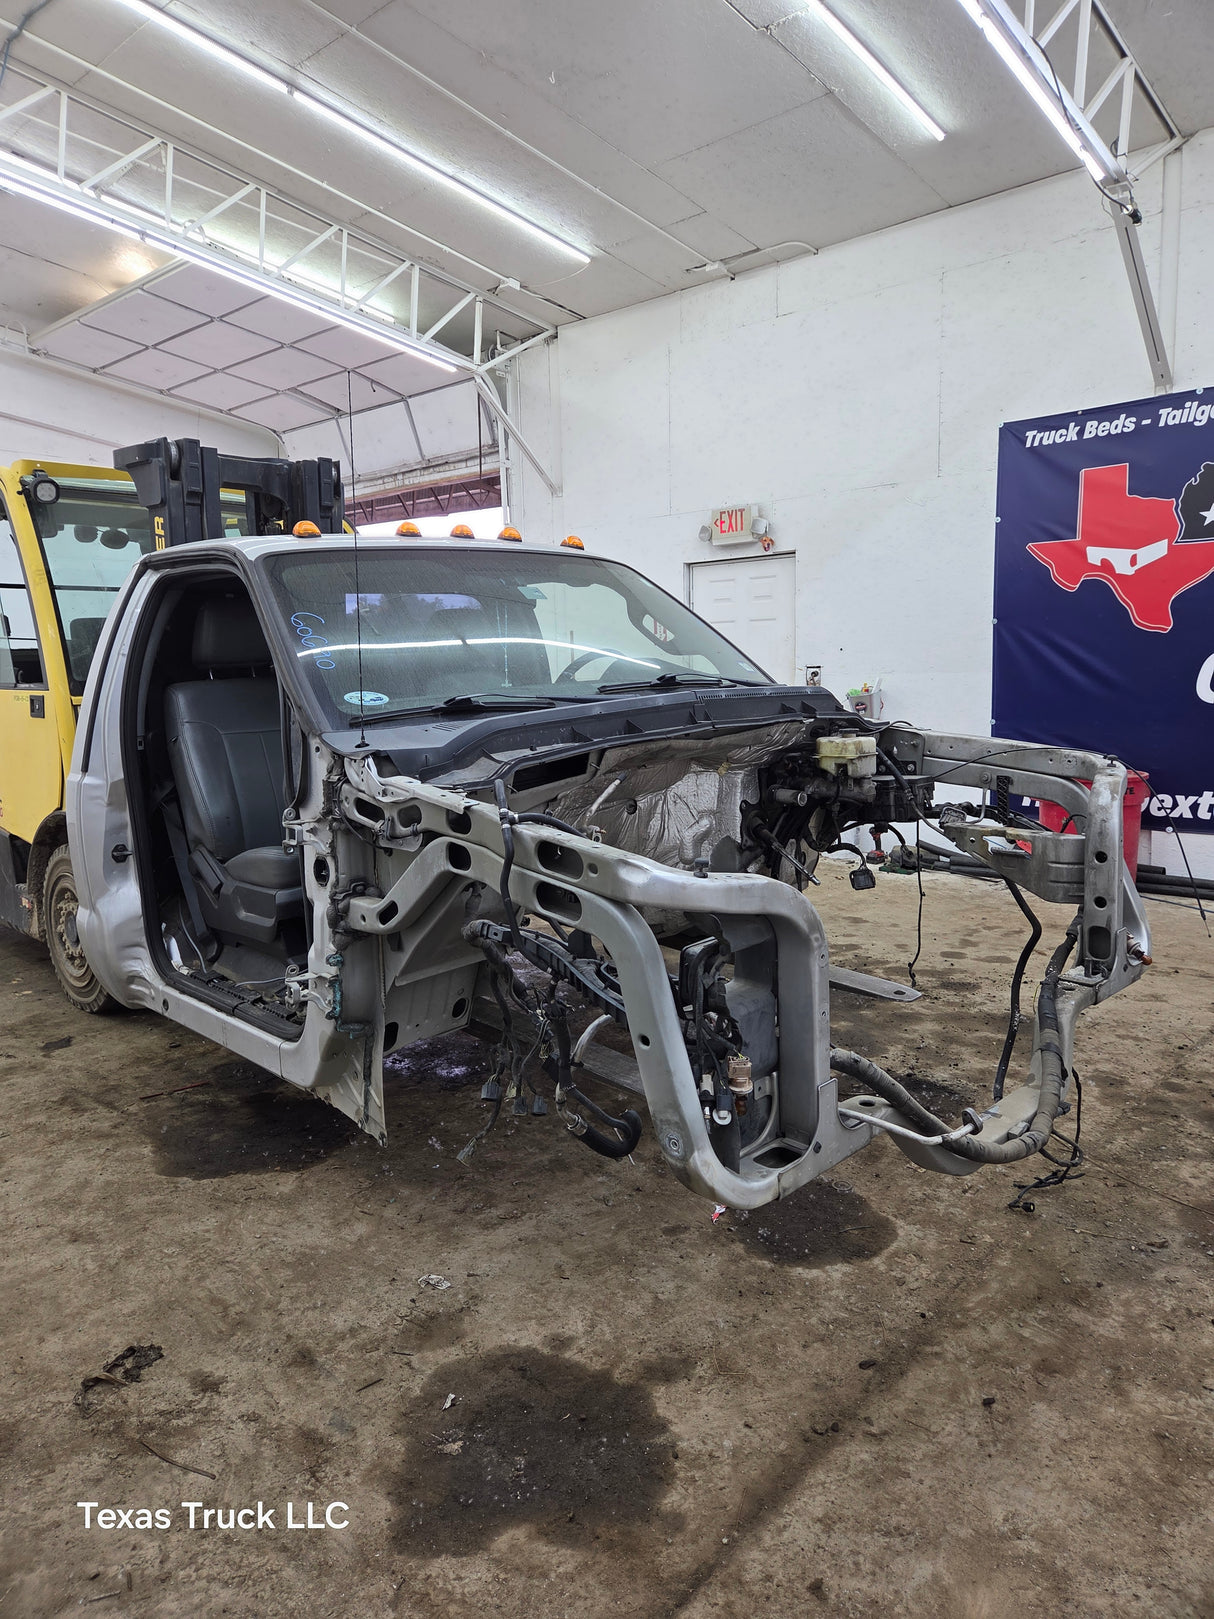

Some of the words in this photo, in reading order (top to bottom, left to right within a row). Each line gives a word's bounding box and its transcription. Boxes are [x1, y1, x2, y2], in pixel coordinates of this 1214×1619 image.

[1024, 422, 1081, 448] Truck
[1082, 413, 1137, 439] Beds
[154, 516, 166, 552] ER
[719, 508, 746, 534] EXIT
